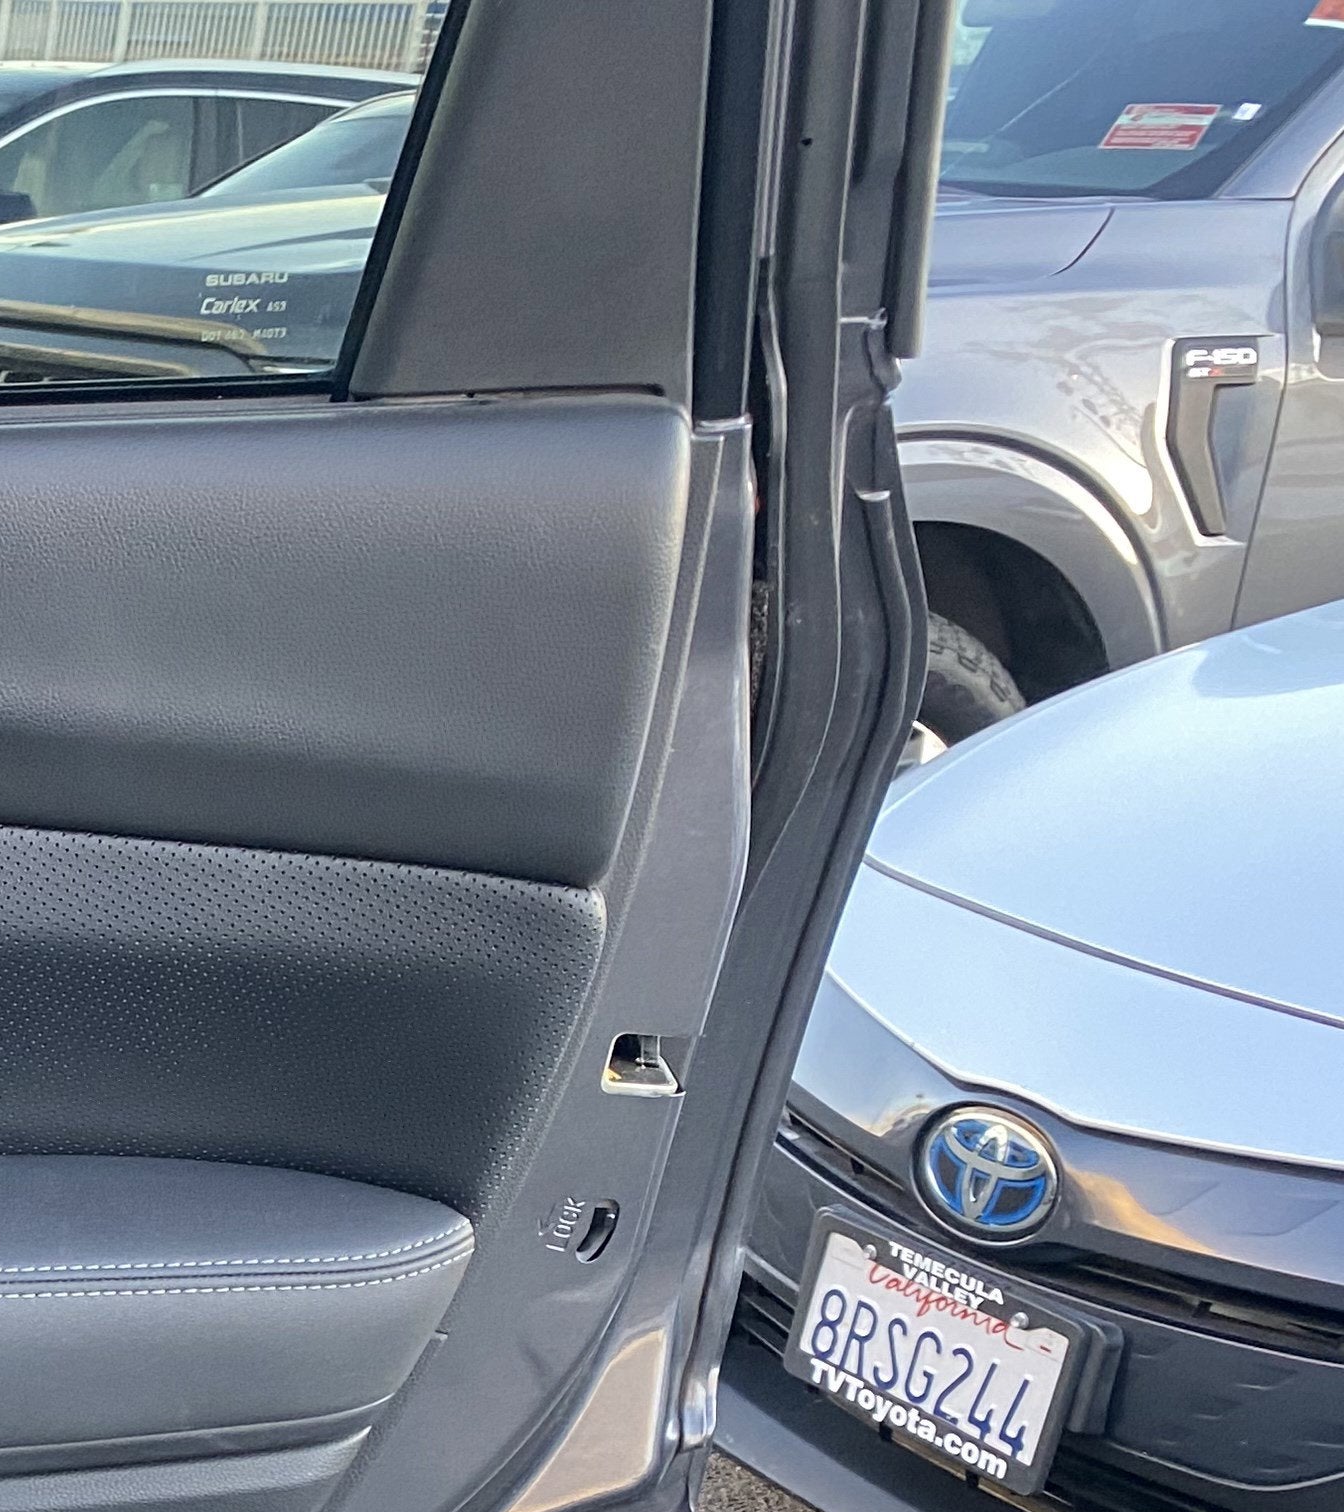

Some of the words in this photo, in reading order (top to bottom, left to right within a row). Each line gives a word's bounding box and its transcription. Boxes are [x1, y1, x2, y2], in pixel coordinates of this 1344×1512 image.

[200, 296, 261, 315] Carlex
[205, 272, 289, 287] SUBARU
[545, 1197, 586, 1252] LOCK
[888, 1240, 1005, 1306] TEMECULA
[902, 1263, 987, 1310] VALLEY
[811, 1286, 1031, 1462] 8RSG244
[810, 1357, 1008, 1479] TVToyota.com
